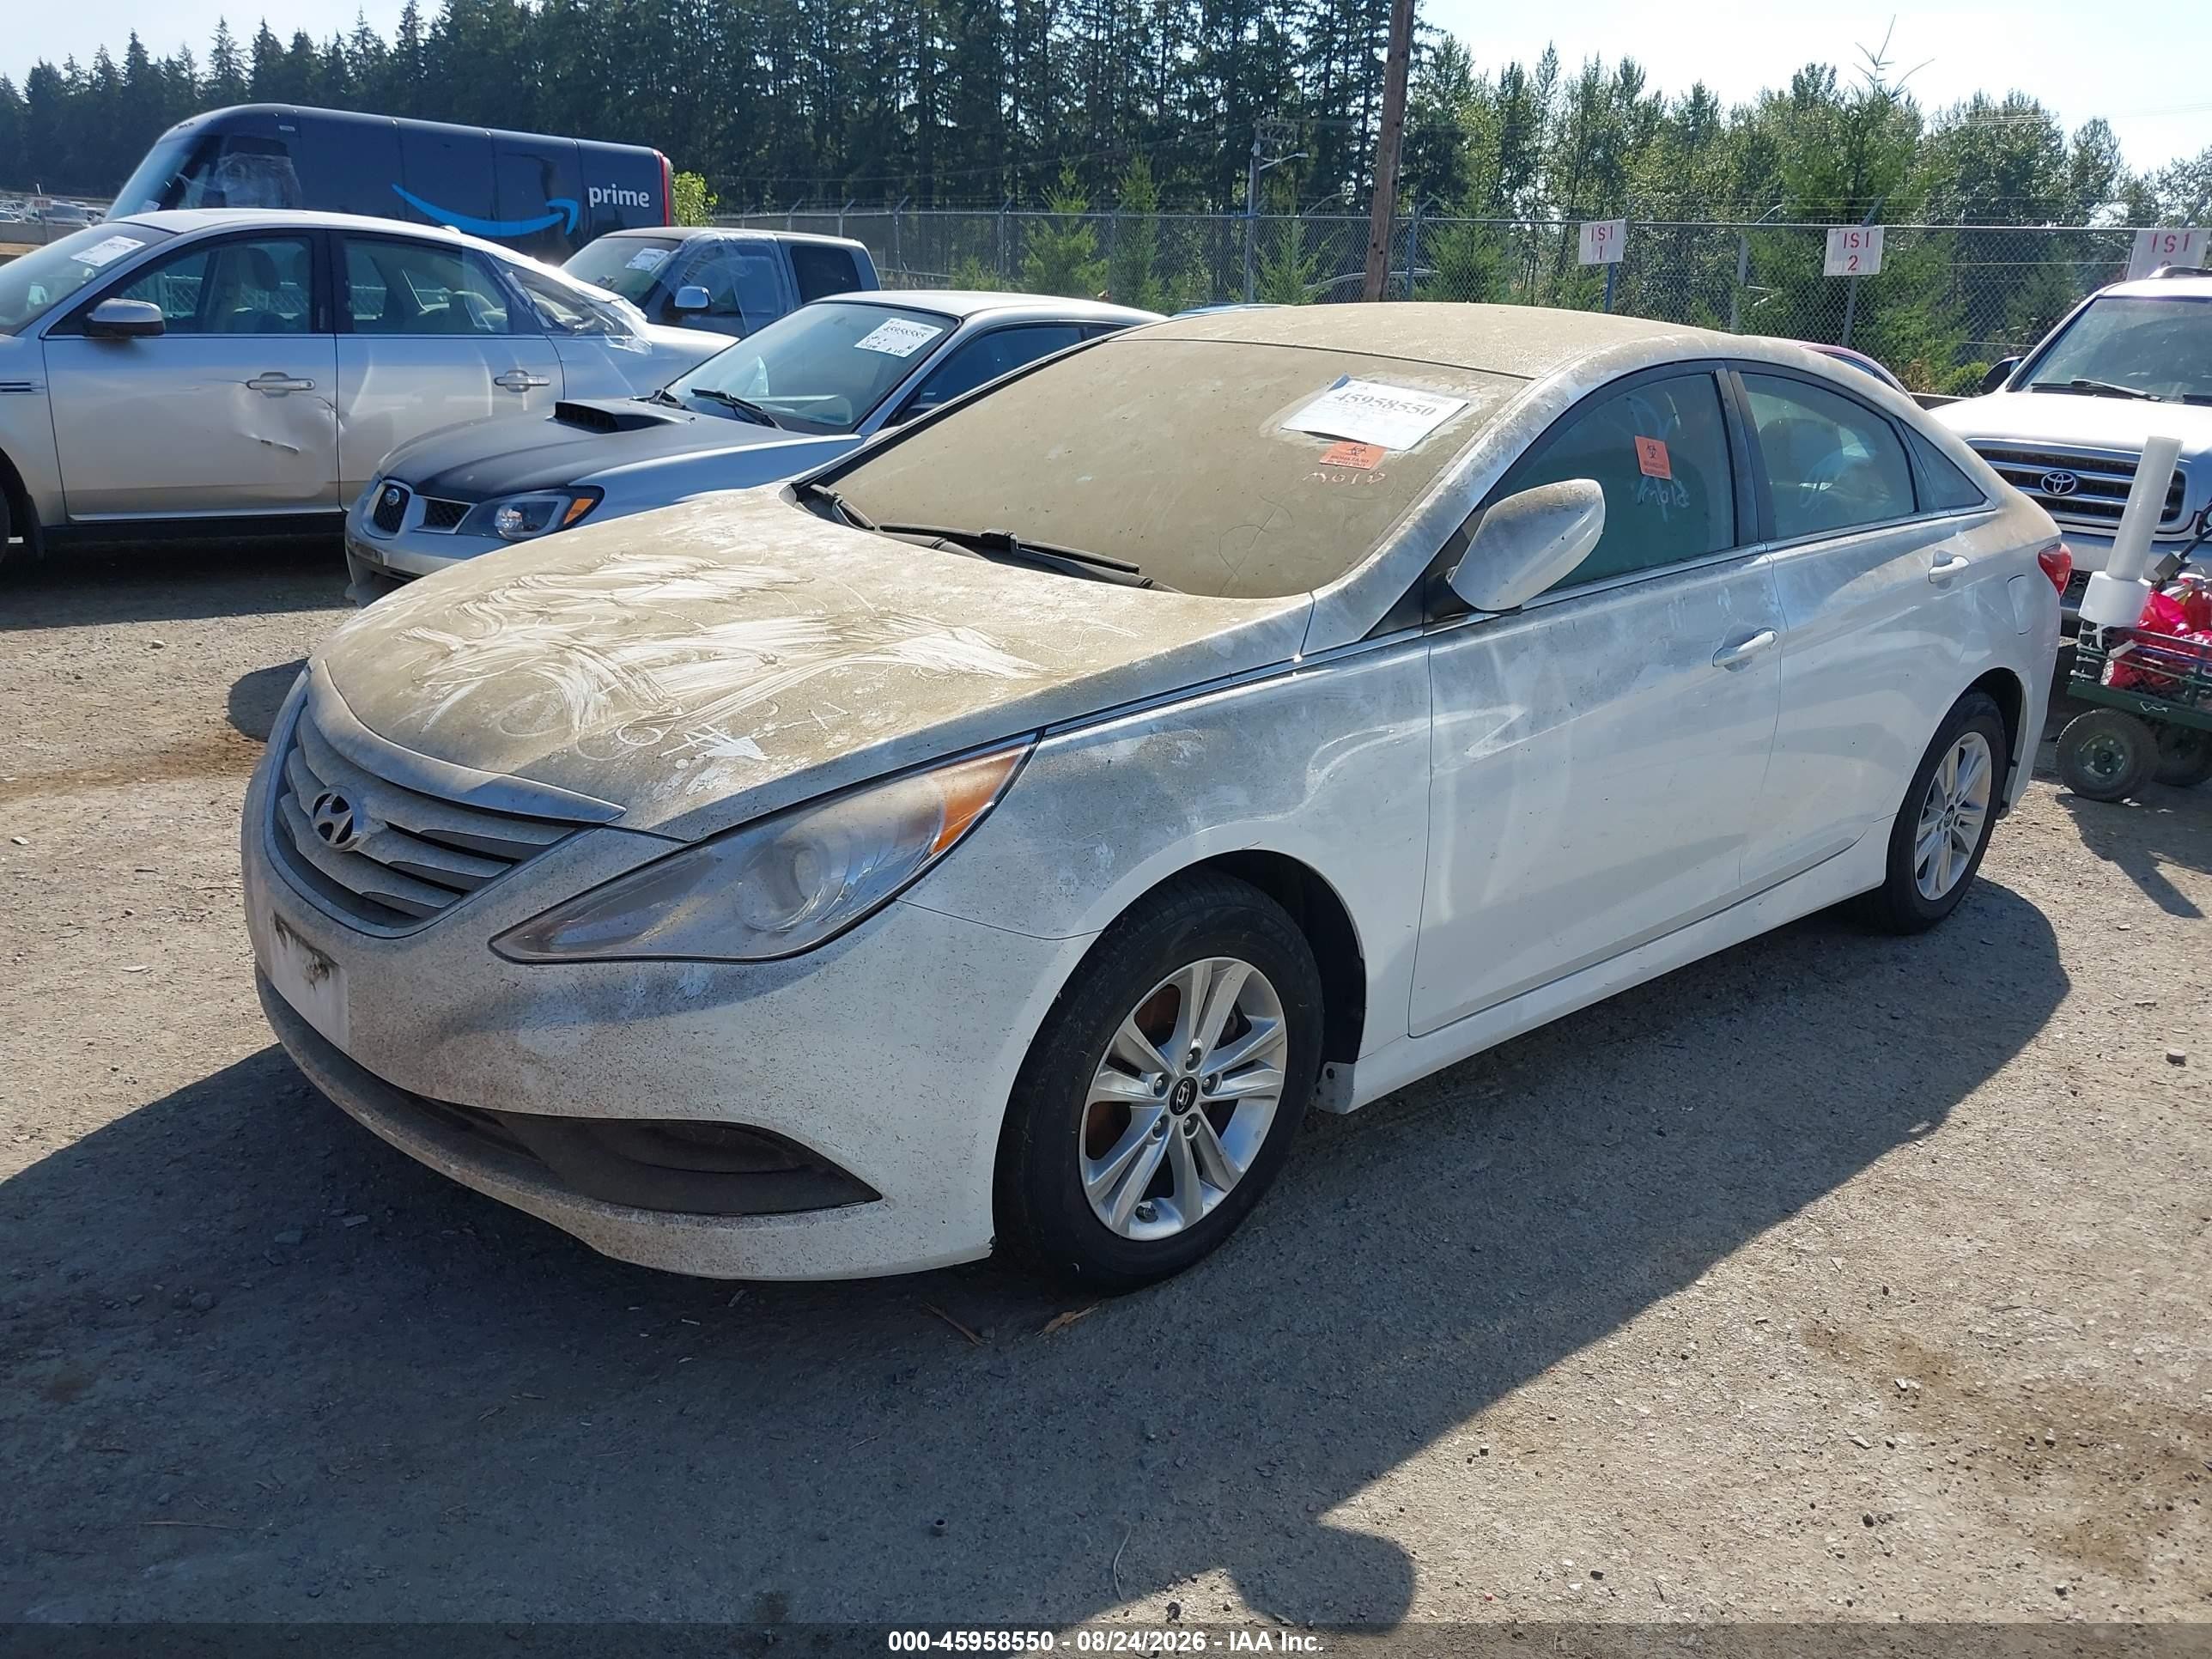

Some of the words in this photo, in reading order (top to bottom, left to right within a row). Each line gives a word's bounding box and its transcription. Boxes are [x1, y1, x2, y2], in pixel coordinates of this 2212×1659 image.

[588, 183, 650, 208] prime
[1848, 254, 1858, 271] 2
[1334, 392, 1437, 416] 45958550
